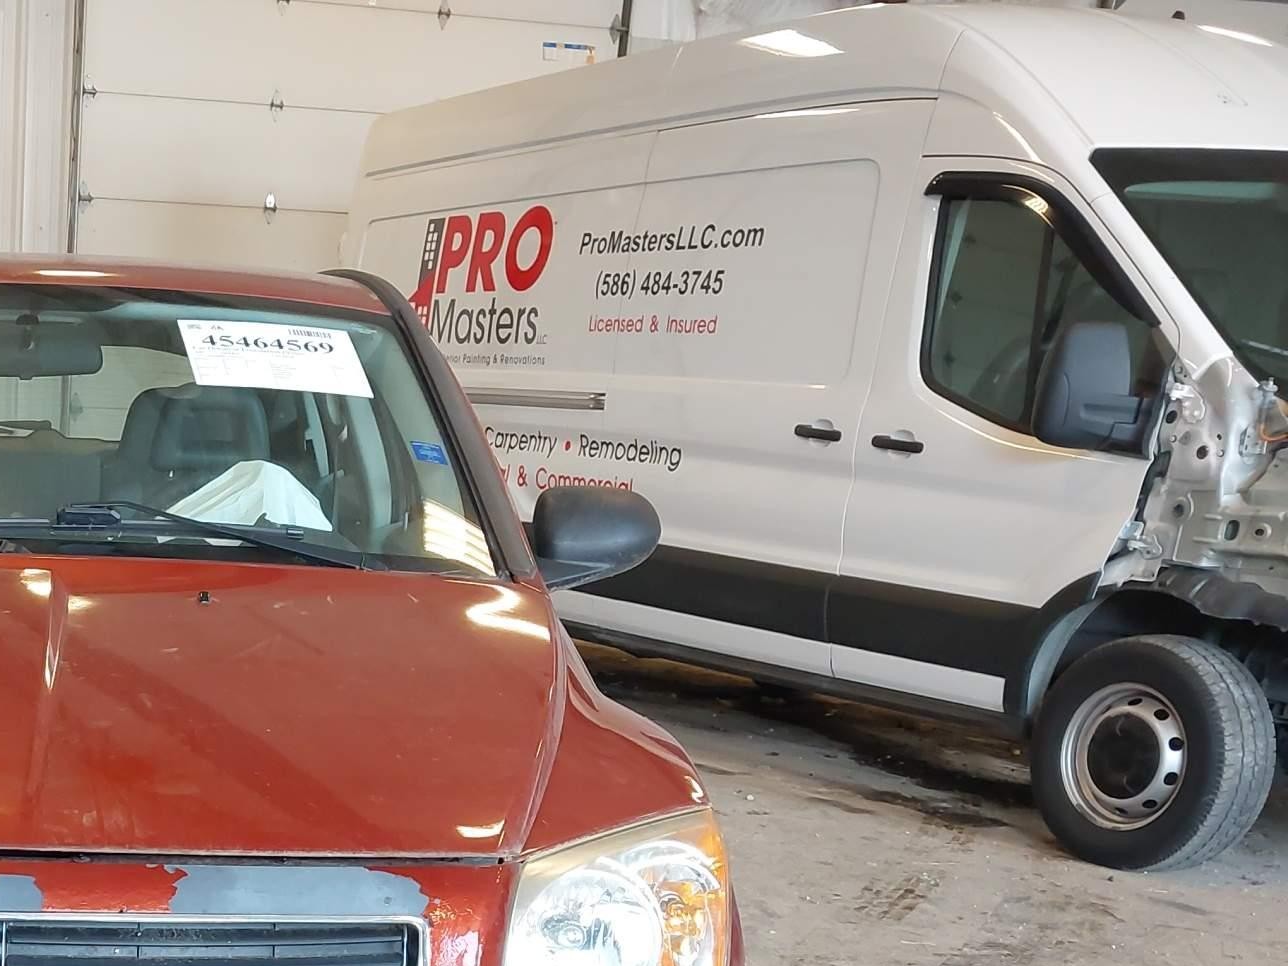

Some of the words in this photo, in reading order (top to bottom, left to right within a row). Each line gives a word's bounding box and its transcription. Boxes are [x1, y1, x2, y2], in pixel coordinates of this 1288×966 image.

[435, 205, 554, 293] PRO
[579, 224, 764, 255] ProMastersLLC.com
[595, 269, 637, 300] (586)
[640, 269, 725, 296] 484-3745
[430, 297, 539, 345] Masters
[588, 315, 644, 333] Licensed
[649, 315, 659, 333] &
[666, 315, 718, 334] Insured
[201, 334, 334, 354] 45464569
[462, 353, 491, 366] Painting
[492, 353, 498, 365] &
[499, 353, 545, 366] Renovations
[484, 426, 558, 459] Carpentry
[578, 433, 683, 472] Remodeling
[517, 465, 528, 487] &
